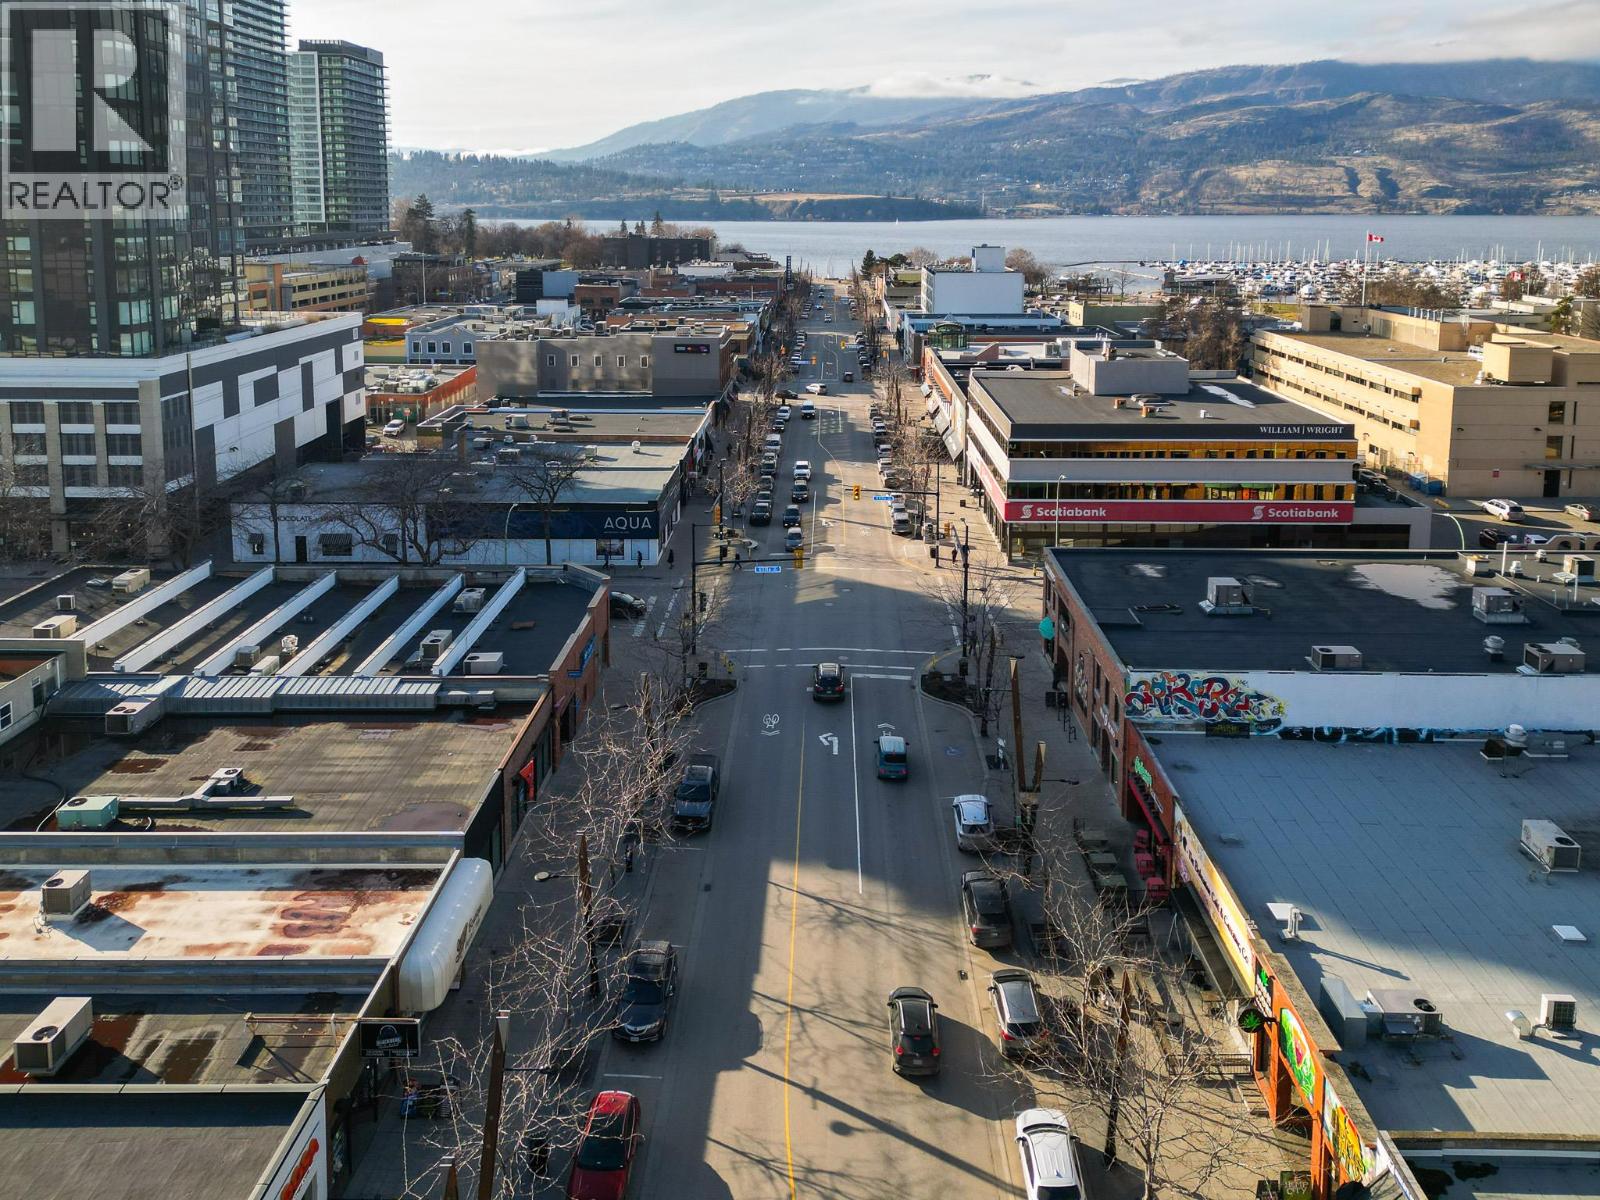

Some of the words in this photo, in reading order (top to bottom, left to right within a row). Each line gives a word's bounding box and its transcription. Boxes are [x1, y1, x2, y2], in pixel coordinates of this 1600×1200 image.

[1260, 426, 1300, 434] WILLIAM
[1306, 426, 1344, 434] WRIGHT
[1037, 507, 1106, 517] Scotiabank
[1268, 508, 1339, 518] Scotiabank
[604, 516, 652, 530] AQUA
